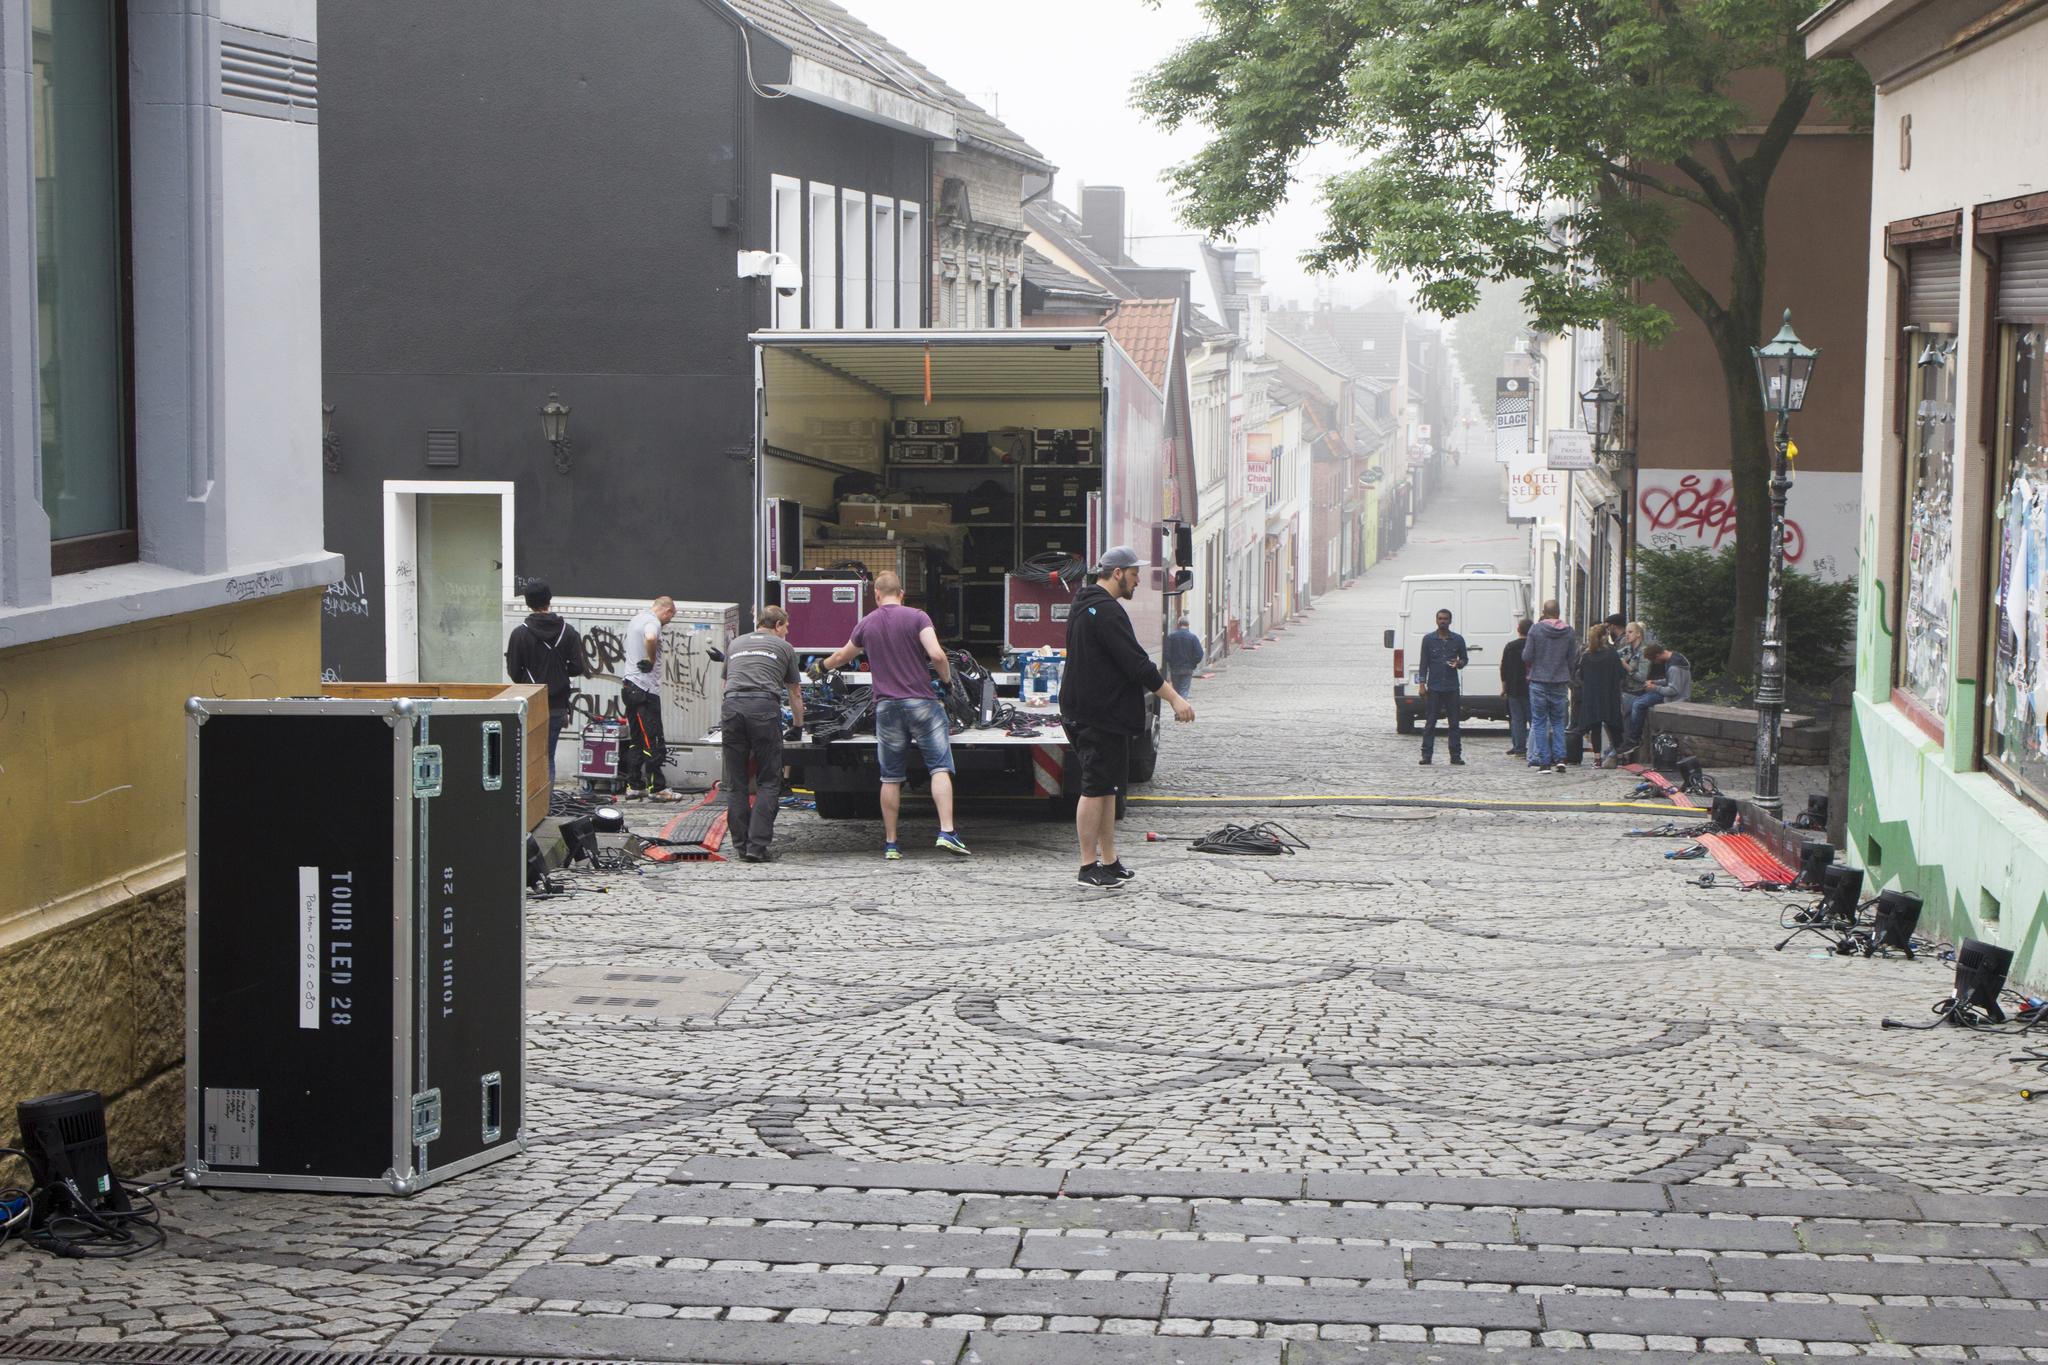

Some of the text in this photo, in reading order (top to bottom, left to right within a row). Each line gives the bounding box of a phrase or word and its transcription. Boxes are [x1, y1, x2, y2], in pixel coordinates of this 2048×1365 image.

[1497, 413, 1528, 426] BLACK
[1247, 474, 1272, 483] China
[1512, 473, 1558, 484] HOTEL
[1512, 485, 1558, 496] SELECT
[331, 871, 353, 1025] TOUR LED 28
[443, 866, 454, 1019] TOUR LED 28
